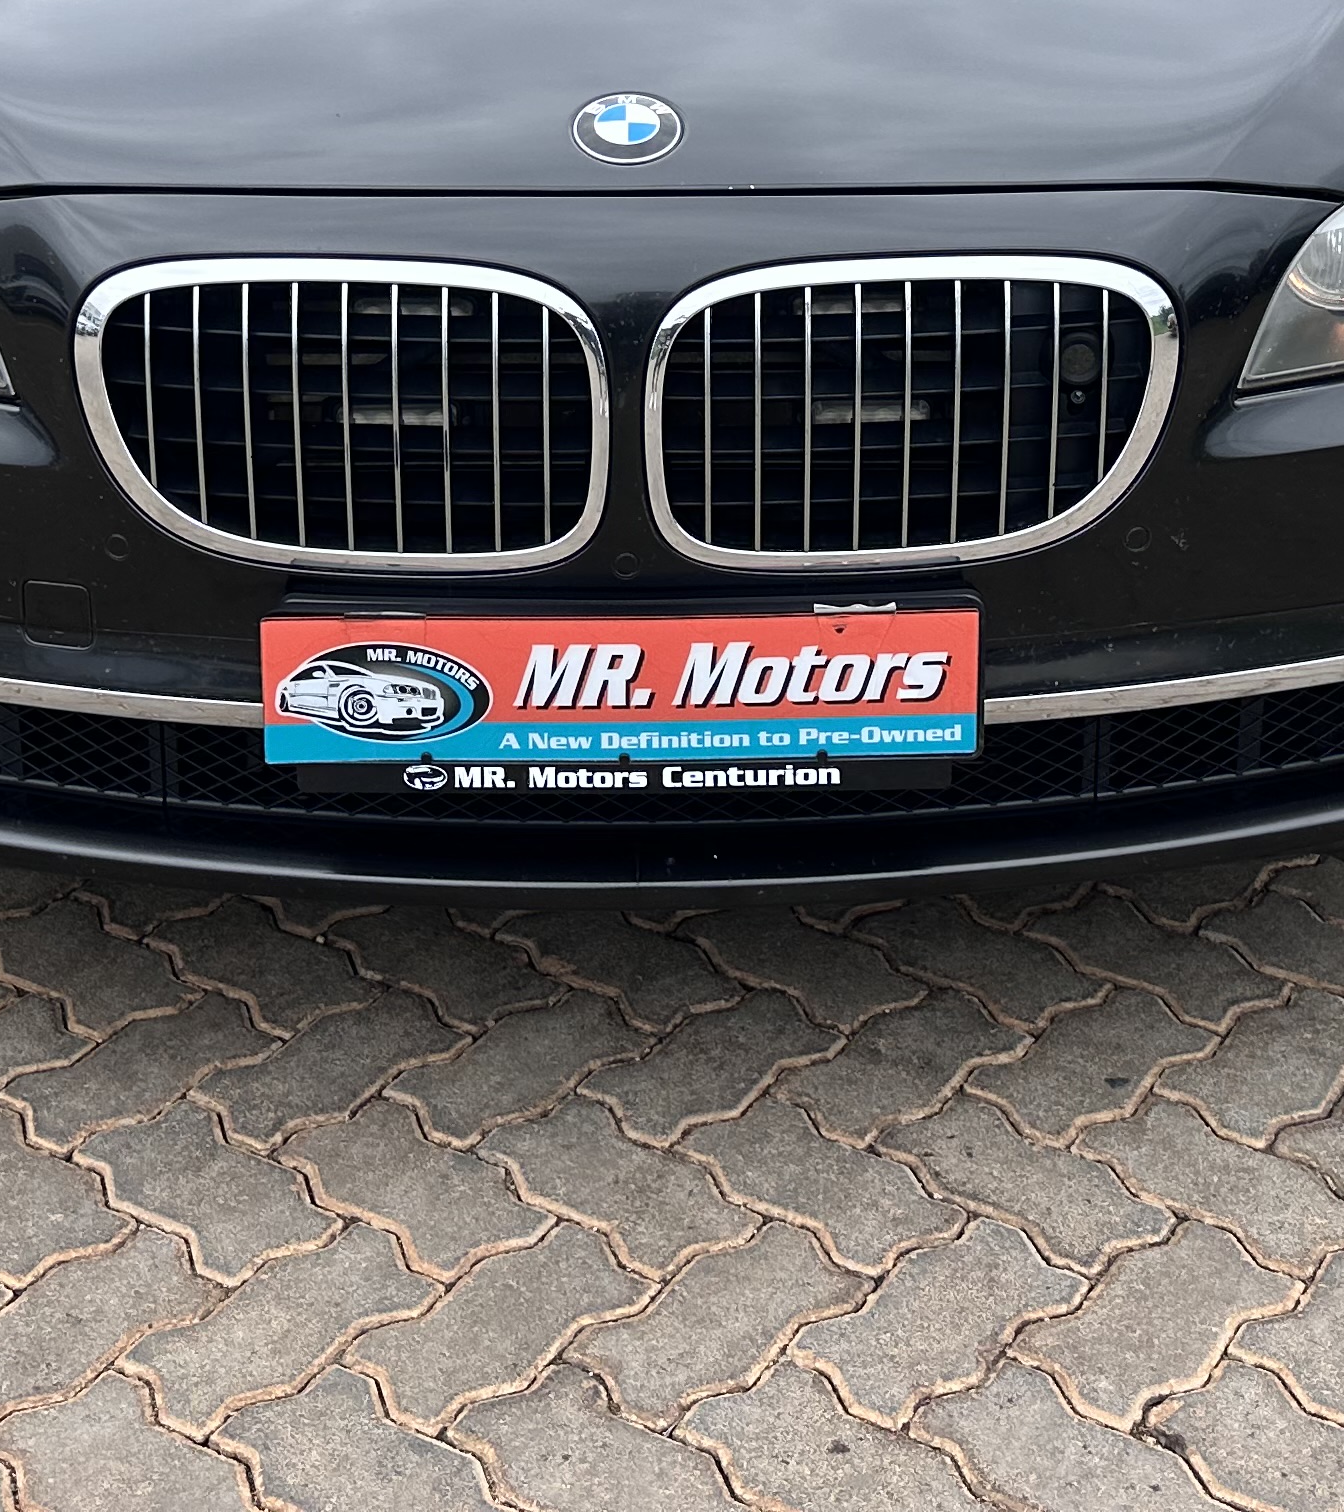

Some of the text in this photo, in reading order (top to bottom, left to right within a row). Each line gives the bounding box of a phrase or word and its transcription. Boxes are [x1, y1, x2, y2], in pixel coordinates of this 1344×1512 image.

[366, 648, 480, 691] MR. MOTORS
[513, 640, 950, 709] MR. Motors
[498, 723, 962, 750] A New Definition to Pre-Owned
[454, 762, 842, 790] MR. Motors Centurion
